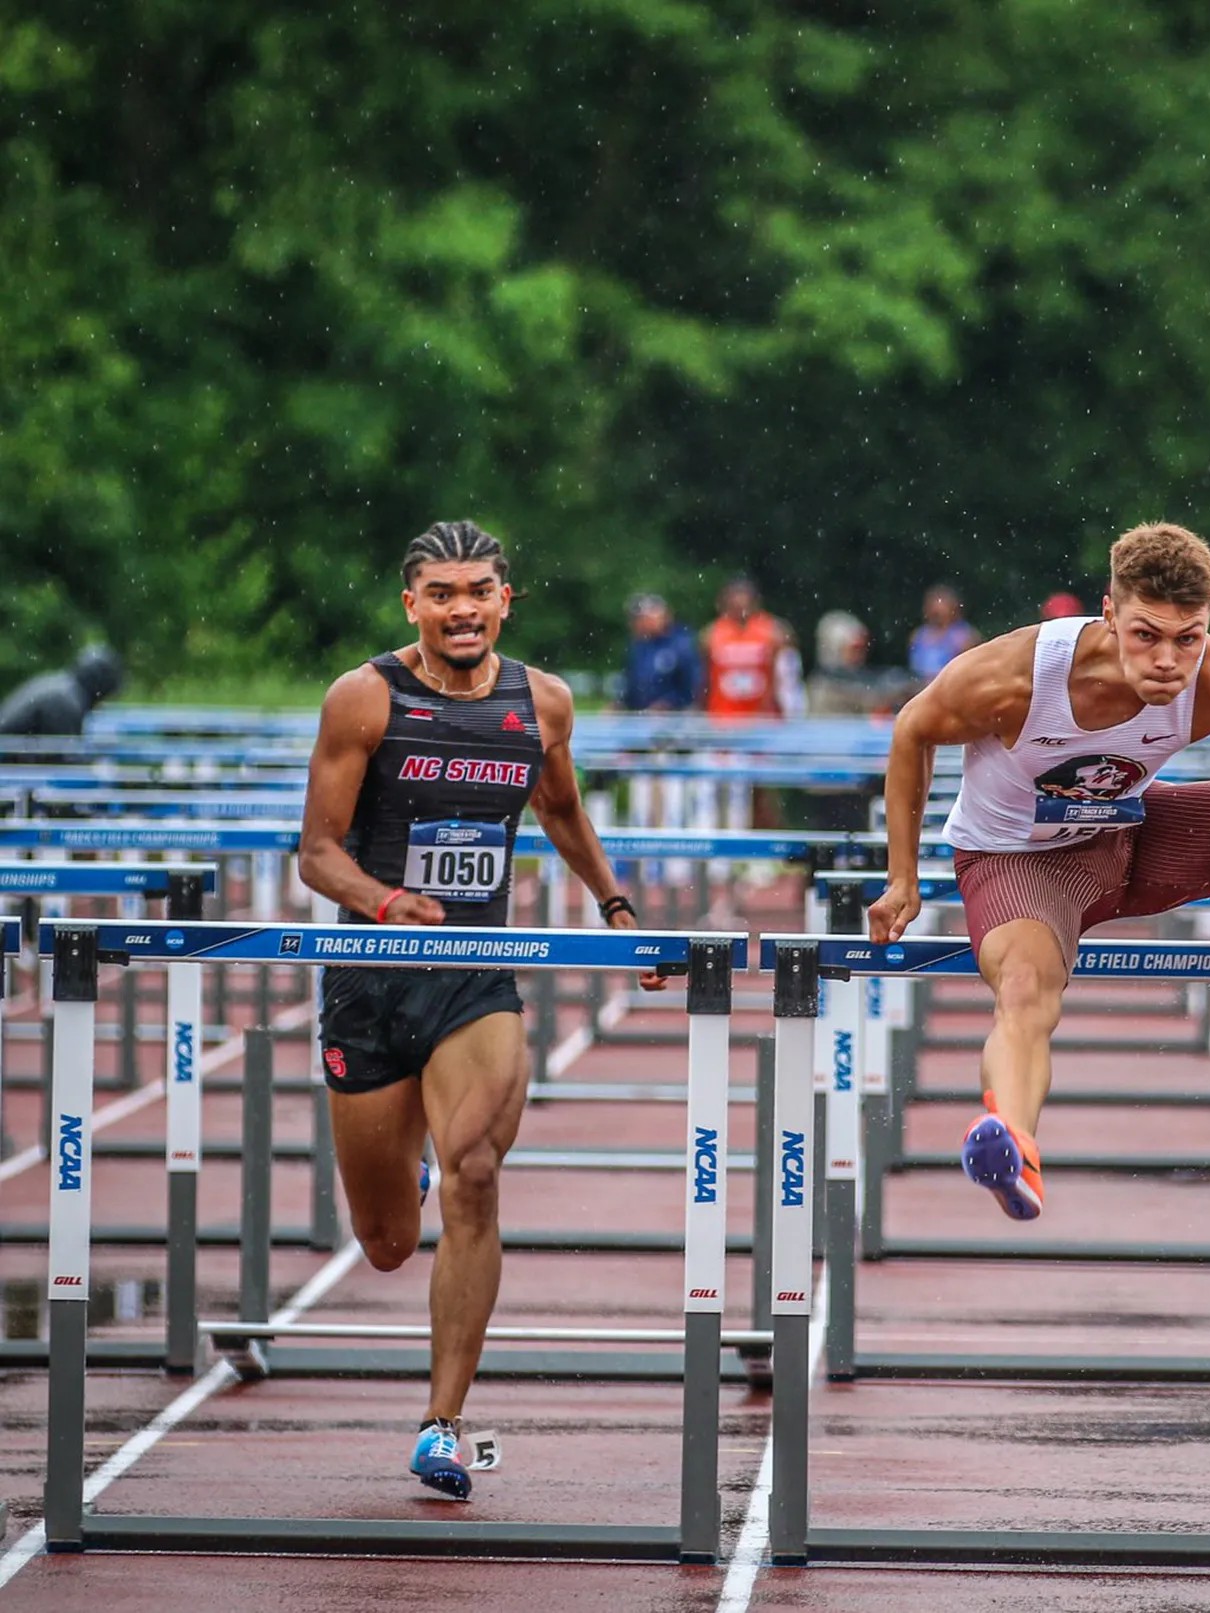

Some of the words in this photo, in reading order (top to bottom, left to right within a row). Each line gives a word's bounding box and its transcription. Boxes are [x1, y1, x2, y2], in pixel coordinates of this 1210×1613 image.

[398, 755, 443, 780] NC
[446, 759, 531, 788] STATE
[421, 852, 495, 886] 1050
[125, 935, 152, 944] GILL
[314, 937, 363, 953] TRACK
[365, 938, 377, 953] &
[378, 939, 419, 954] FIELD
[422, 940, 550, 957] CHAMPIONSHIPS
[635, 945, 661, 955] GILL
[845, 950, 872, 959] GILL
[1085, 953, 1097, 968] &
[1099, 953, 1140, 969] FIELD
[175, 1022, 193, 1083] NCAA
[834, 1030, 852, 1091] NCAA
[59, 1114, 82, 1190] NCAA
[694, 1127, 717, 1203] NCAA
[781, 1131, 804, 1206] NCAA
[53, 1276, 82, 1286] GILL
[689, 1289, 718, 1298] GILL
[777, 1291, 806, 1301] GILL
[475, 1440, 495, 1467] 5
